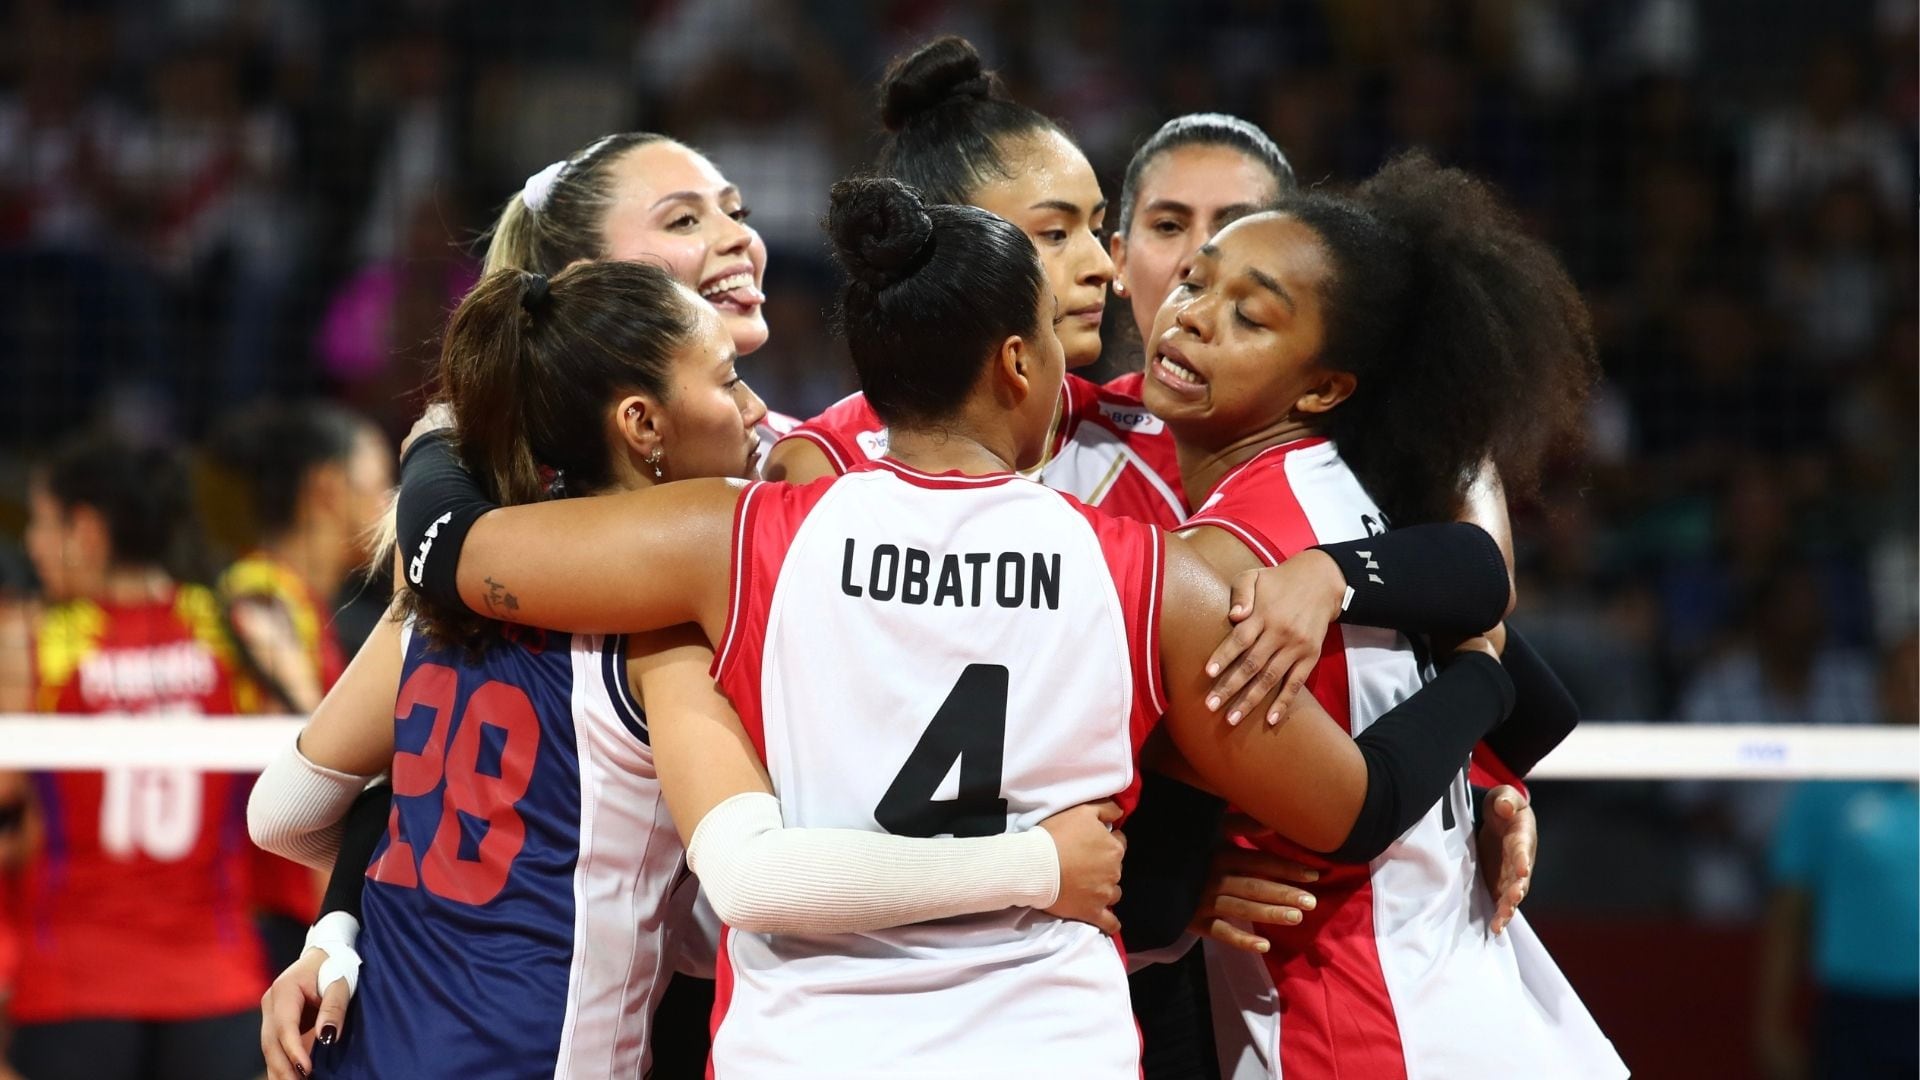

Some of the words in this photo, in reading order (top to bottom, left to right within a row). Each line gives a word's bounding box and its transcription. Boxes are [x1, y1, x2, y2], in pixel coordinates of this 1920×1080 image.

[841, 538, 1061, 610] LOBATON
[365, 662, 541, 906] 28
[874, 663, 1009, 838] 4
